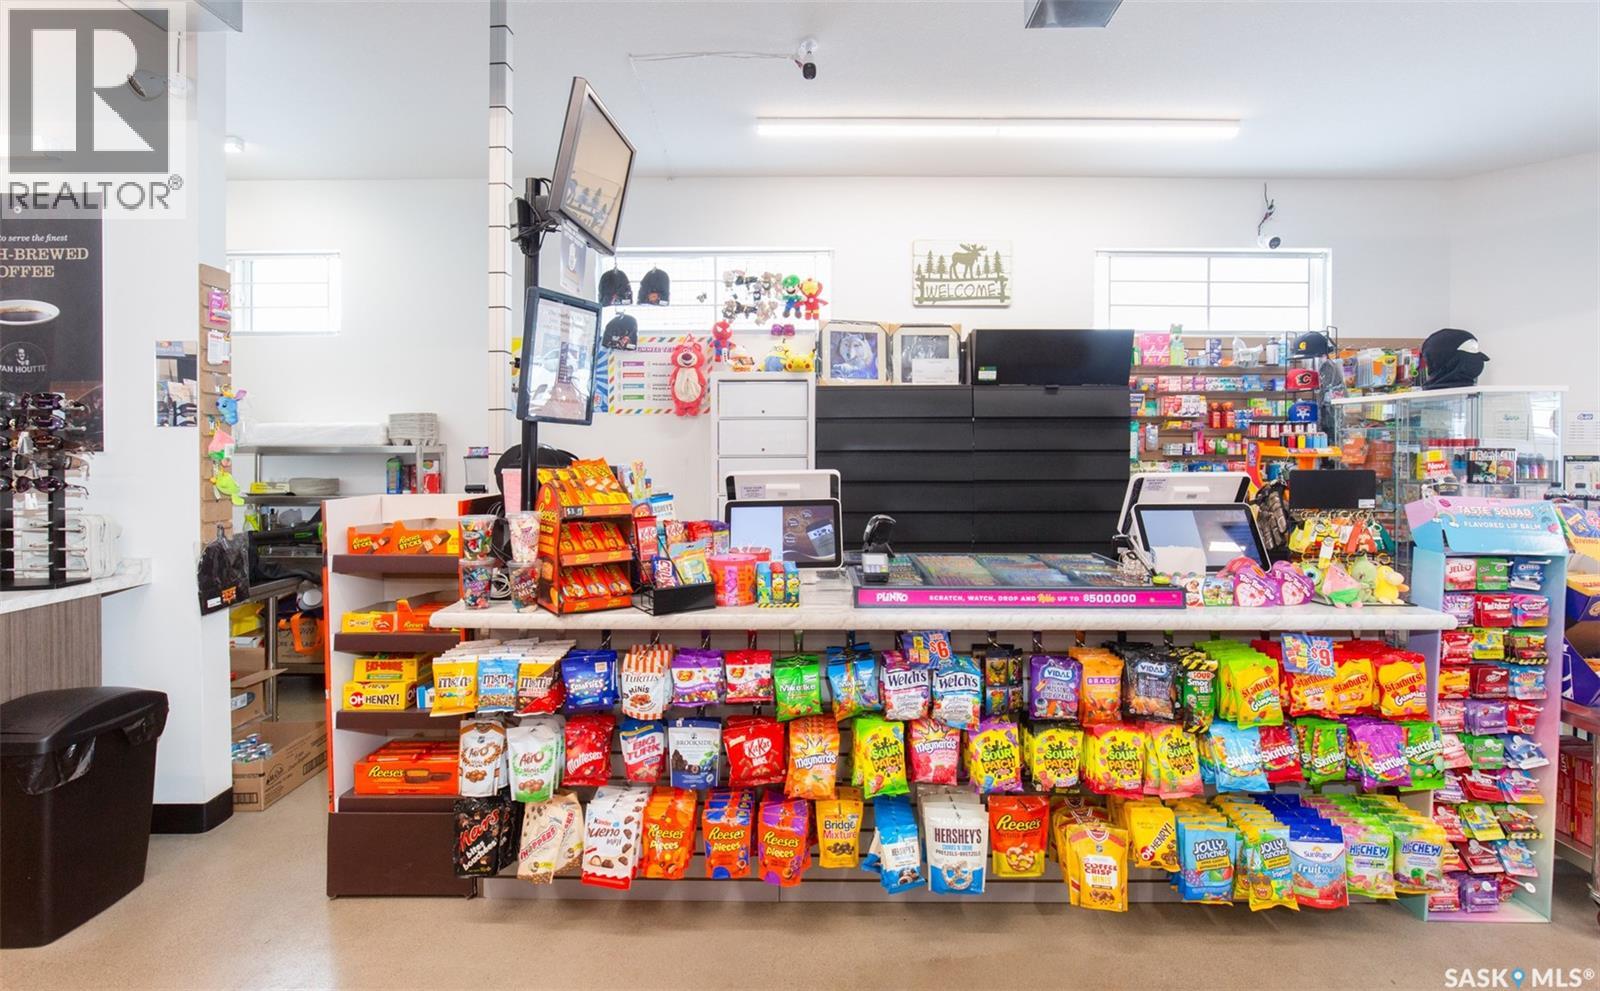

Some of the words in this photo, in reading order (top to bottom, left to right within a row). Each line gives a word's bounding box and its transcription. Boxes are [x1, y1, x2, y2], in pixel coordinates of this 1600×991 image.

[8, 234, 30, 242] serve
[32, 232, 44, 242] the
[45, 233, 68, 243] finest
[925, 282, 996, 297] WELCOME
[1457, 505, 1490, 516] TASTE
[1494, 506, 1535, 518] SQUAD
[1463, 520, 1504, 529] FLAVORED
[399, 539, 423, 550] STICKS
[998, 594, 1018, 602] DROP
[1020, 594, 1037, 602] AND
[1083, 593, 1136, 604] $500,000
[929, 640, 950, 659] $6
[1311, 646, 1332, 668] $9
[1046, 669, 1071, 678] VIDAL
[1140, 663, 1165, 674] VIDAL
[888, 671, 927, 687] Welch's
[939, 674, 978, 688] Welch's
[1384, 672, 1424, 692] Starburst
[1241, 677, 1276, 698] Starburst
[349, 694, 365, 704] OH
[365, 694, 400, 706] HENRY!
[633, 735, 656, 750] BIG
[1405, 739, 1443, 758] Skittles
[626, 743, 661, 759] TURK
[871, 746, 900, 758] SOUR
[982, 748, 1012, 761] SOUR
[1045, 749, 1076, 760] SOUR
[1108, 750, 1137, 760] SOUR
[1168, 747, 1192, 758] SOUR
[1261, 744, 1299, 762] Skittles
[567, 750, 603, 775] Maltesers
[873, 754, 902, 768] PATCH
[983, 759, 1015, 771] PATCH
[1045, 759, 1076, 769] PATCH
[1109, 760, 1139, 769] PATCH
[1169, 756, 1194, 768] PATCH
[1373, 755, 1408, 774] Skittles
[368, 765, 404, 778] Reese's
[824, 820, 856, 832] Bridge
[996, 815, 1042, 832] Reese's
[458, 809, 500, 853] Mars
[647, 824, 685, 840] Reese's
[708, 827, 745, 841] Reese's
[824, 830, 857, 839] Mixture
[934, 827, 982, 844] HERSHEY'S
[1151, 823, 1175, 850] HENRY!
[763, 830, 800, 848] Reese's
[1194, 839, 1225, 855] JOLLY
[1260, 839, 1285, 854] JOLLY
